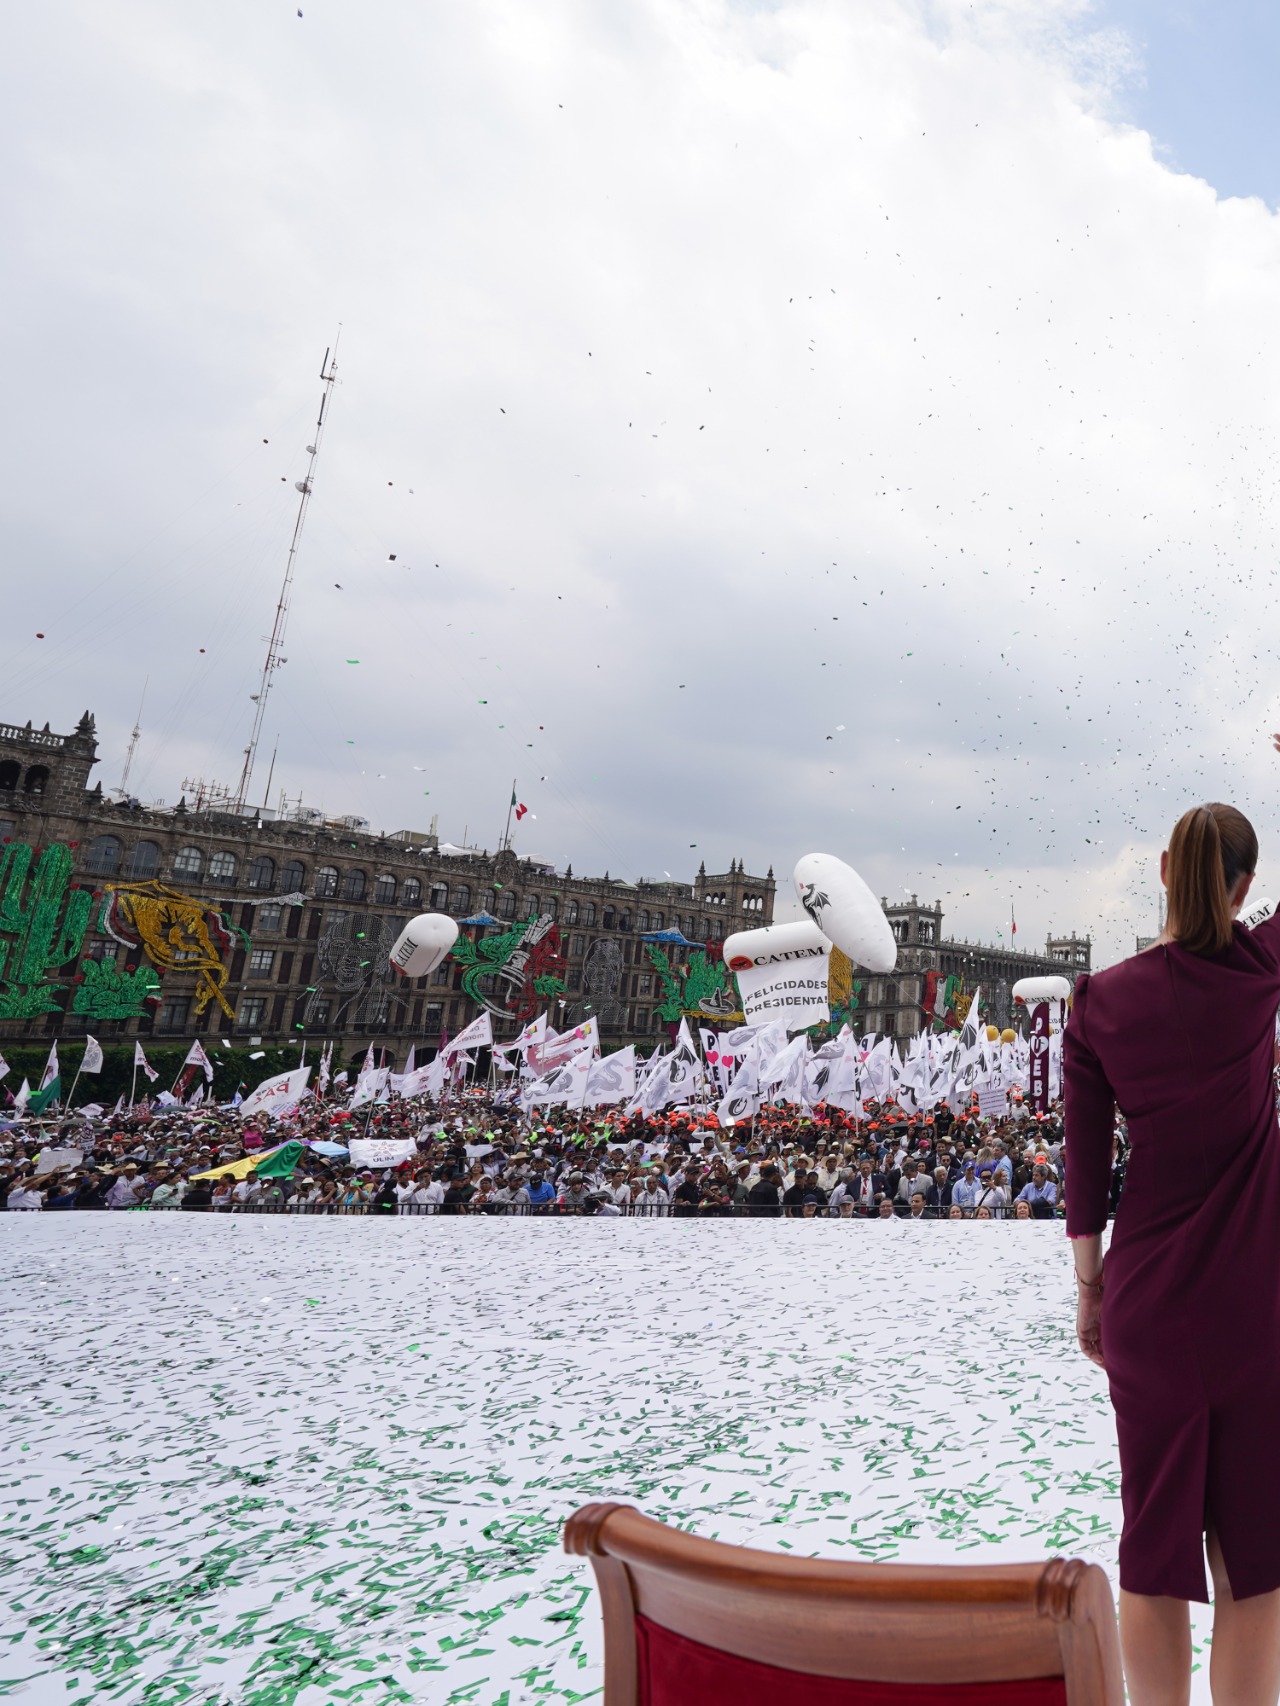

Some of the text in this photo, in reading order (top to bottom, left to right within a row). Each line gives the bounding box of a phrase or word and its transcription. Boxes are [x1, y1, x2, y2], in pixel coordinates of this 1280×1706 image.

[1242, 904, 1271, 928] TEM
[395, 937, 418, 967] CATEM
[753, 946, 825, 966] CATEM
[745, 996, 827, 1015] PRESIDENTA!
[1025, 996, 1057, 1004] CATEM
